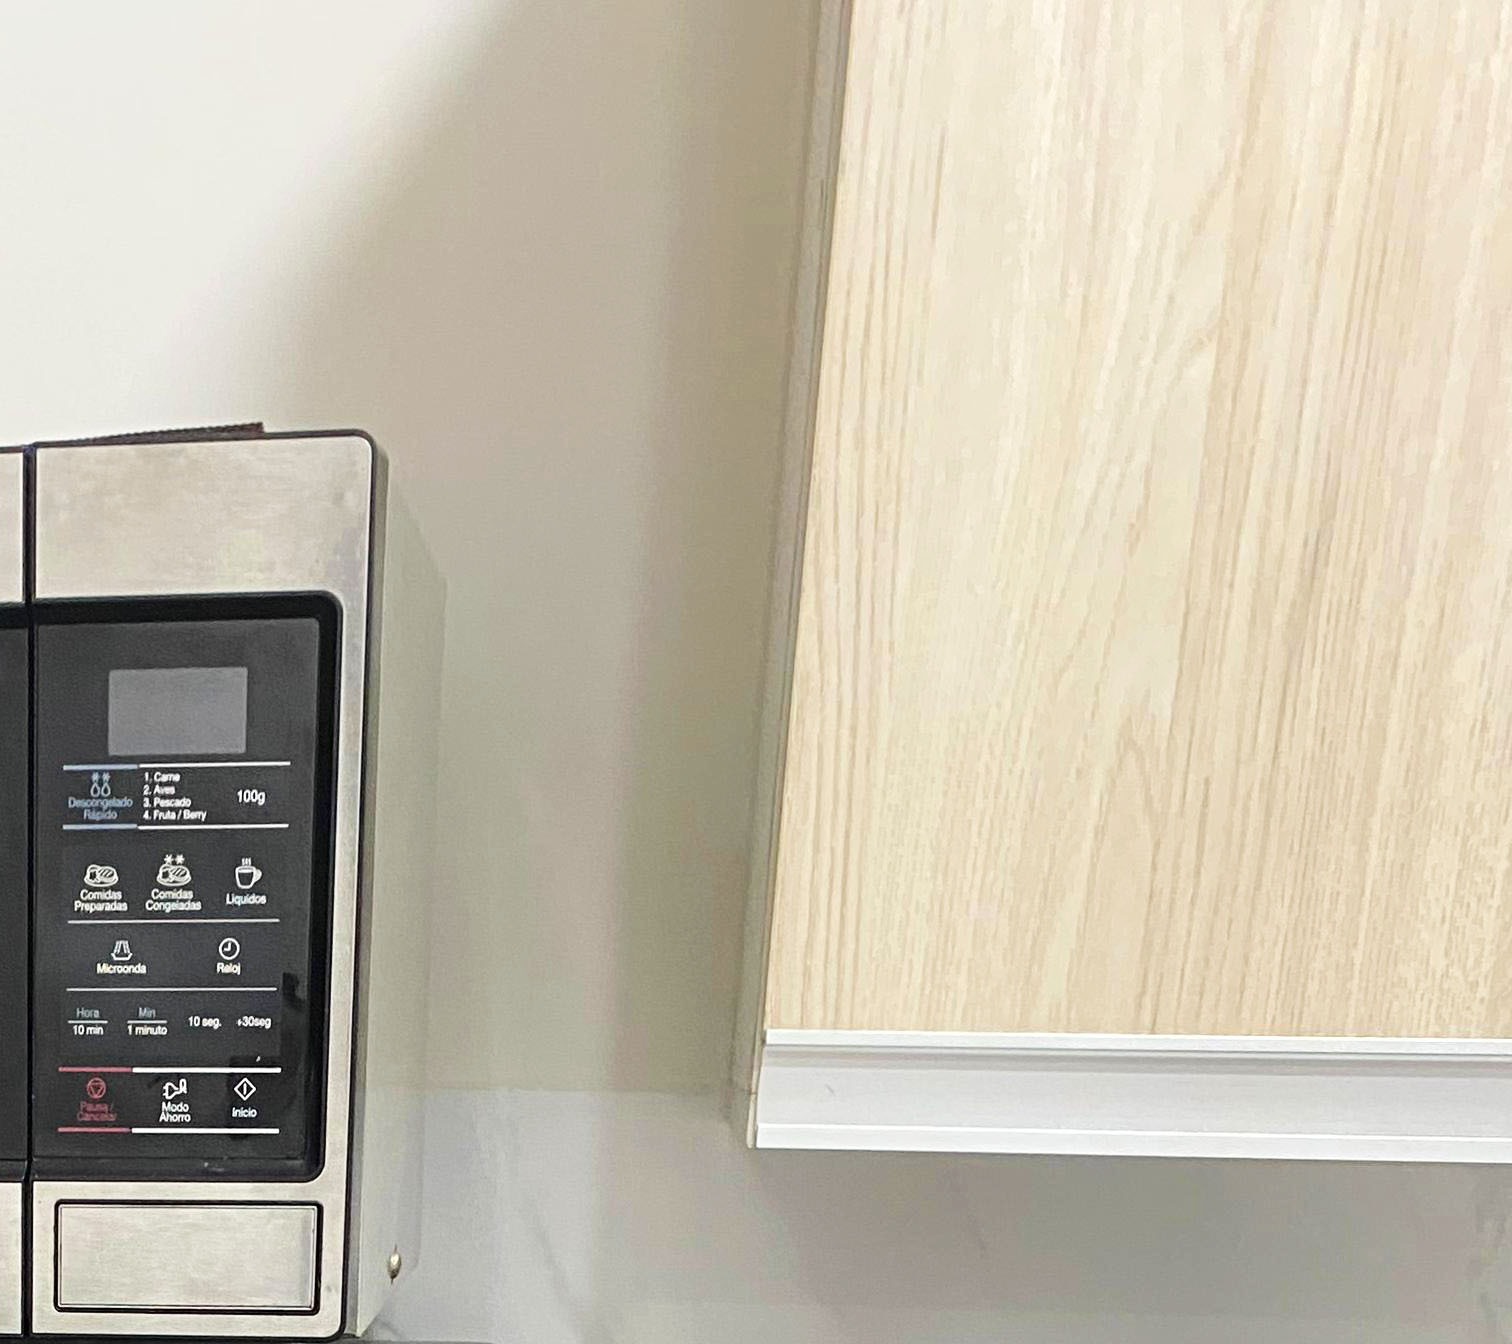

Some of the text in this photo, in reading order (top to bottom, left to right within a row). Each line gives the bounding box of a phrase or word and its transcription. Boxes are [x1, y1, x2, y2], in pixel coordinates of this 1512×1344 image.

[68, 796, 133, 810] Descongelado
[153, 796, 192, 808] Pescado
[237, 789, 266, 806] 100g
[153, 809, 176, 820] Fruta
[183, 809, 207, 822] Berry
[80, 889, 122, 901] Comidas
[151, 889, 193, 901] Comidas
[74, 901, 128, 914] Preparadas
[145, 900, 202, 913] Congeladas
[96, 963, 147, 975] Microonda
[216, 963, 242, 976] Reloj
[76, 1007, 100, 1019] Hora
[138, 1007, 157, 1018] Min
[188, 1016, 200, 1027] 10
[236, 1016, 272, 1029] +30seg
[73, 1025, 104, 1036] 10 min
[134, 1025, 168, 1036] minuto
[162, 1102, 190, 1113] Modo
[159, 1111, 191, 1123] Ahorro
